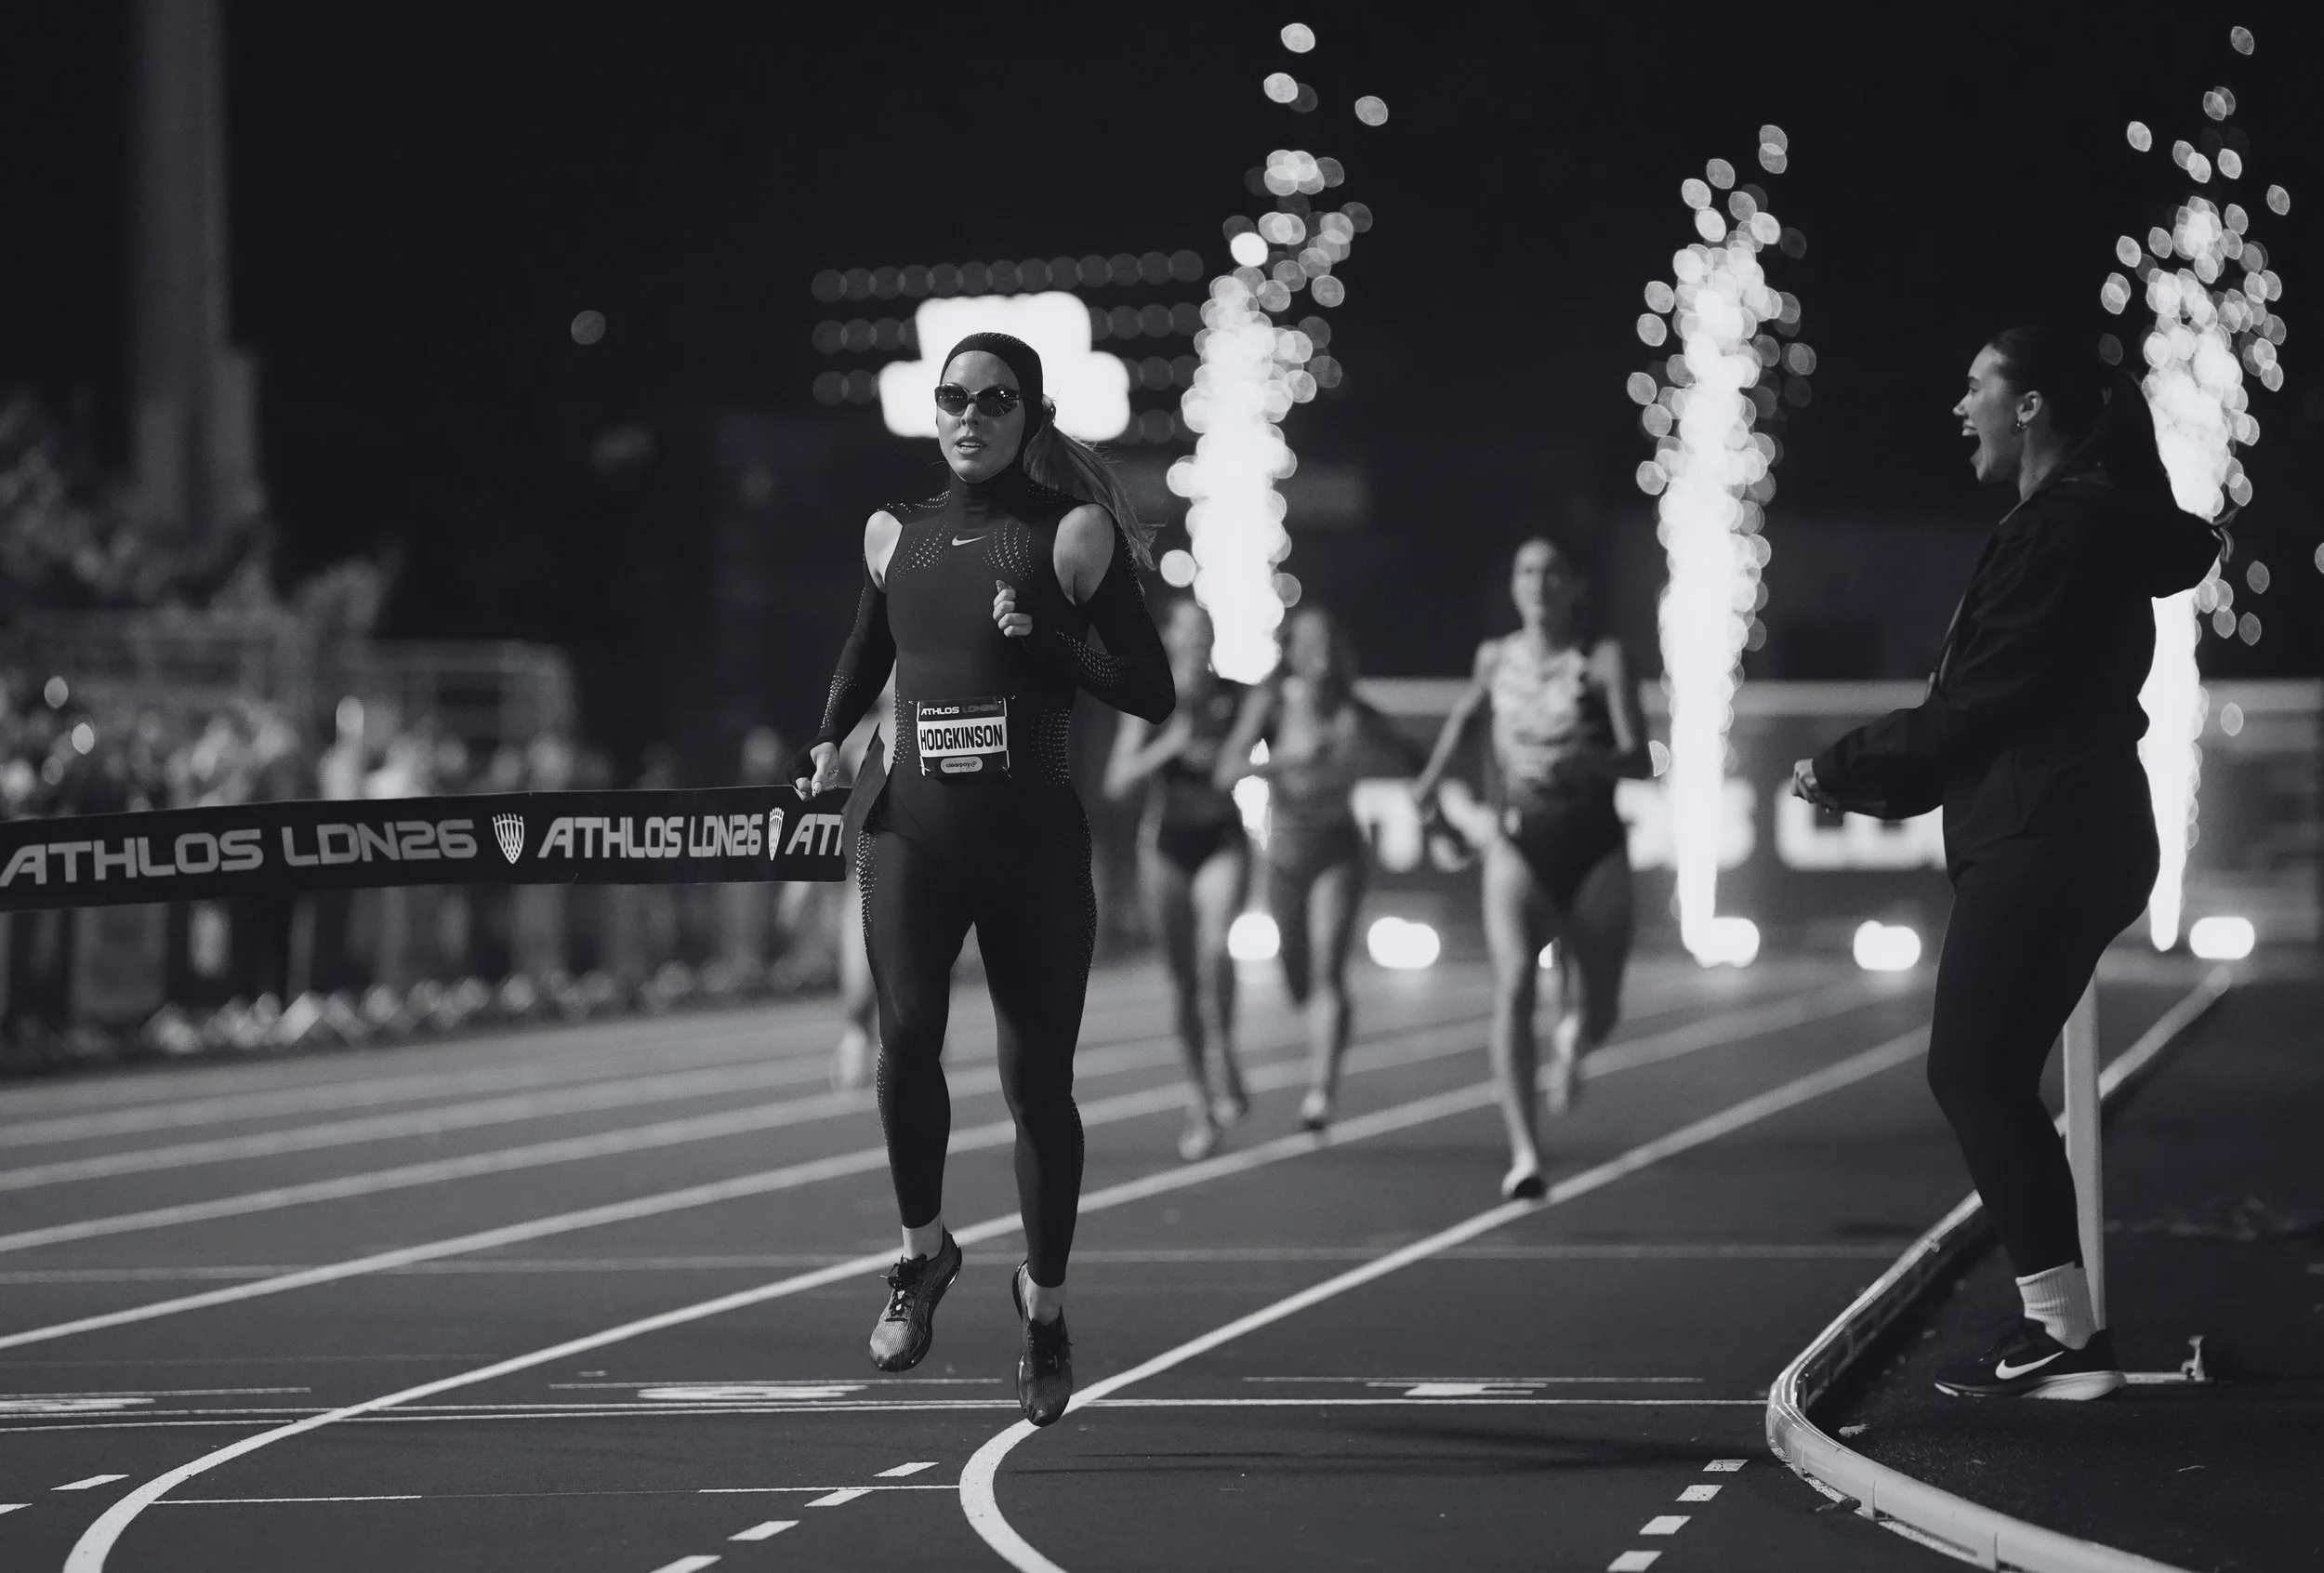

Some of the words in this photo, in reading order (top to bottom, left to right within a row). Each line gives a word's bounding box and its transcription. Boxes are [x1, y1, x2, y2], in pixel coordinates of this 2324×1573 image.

[920, 707, 959, 716] ATHLOS
[919, 724, 1003, 751] HODGKINSON
[0, 829, 264, 887] ATHLOS
[282, 819, 478, 866] LDN26
[537, 816, 684, 858] ATHLOS
[688, 813, 763, 857] LDN26
